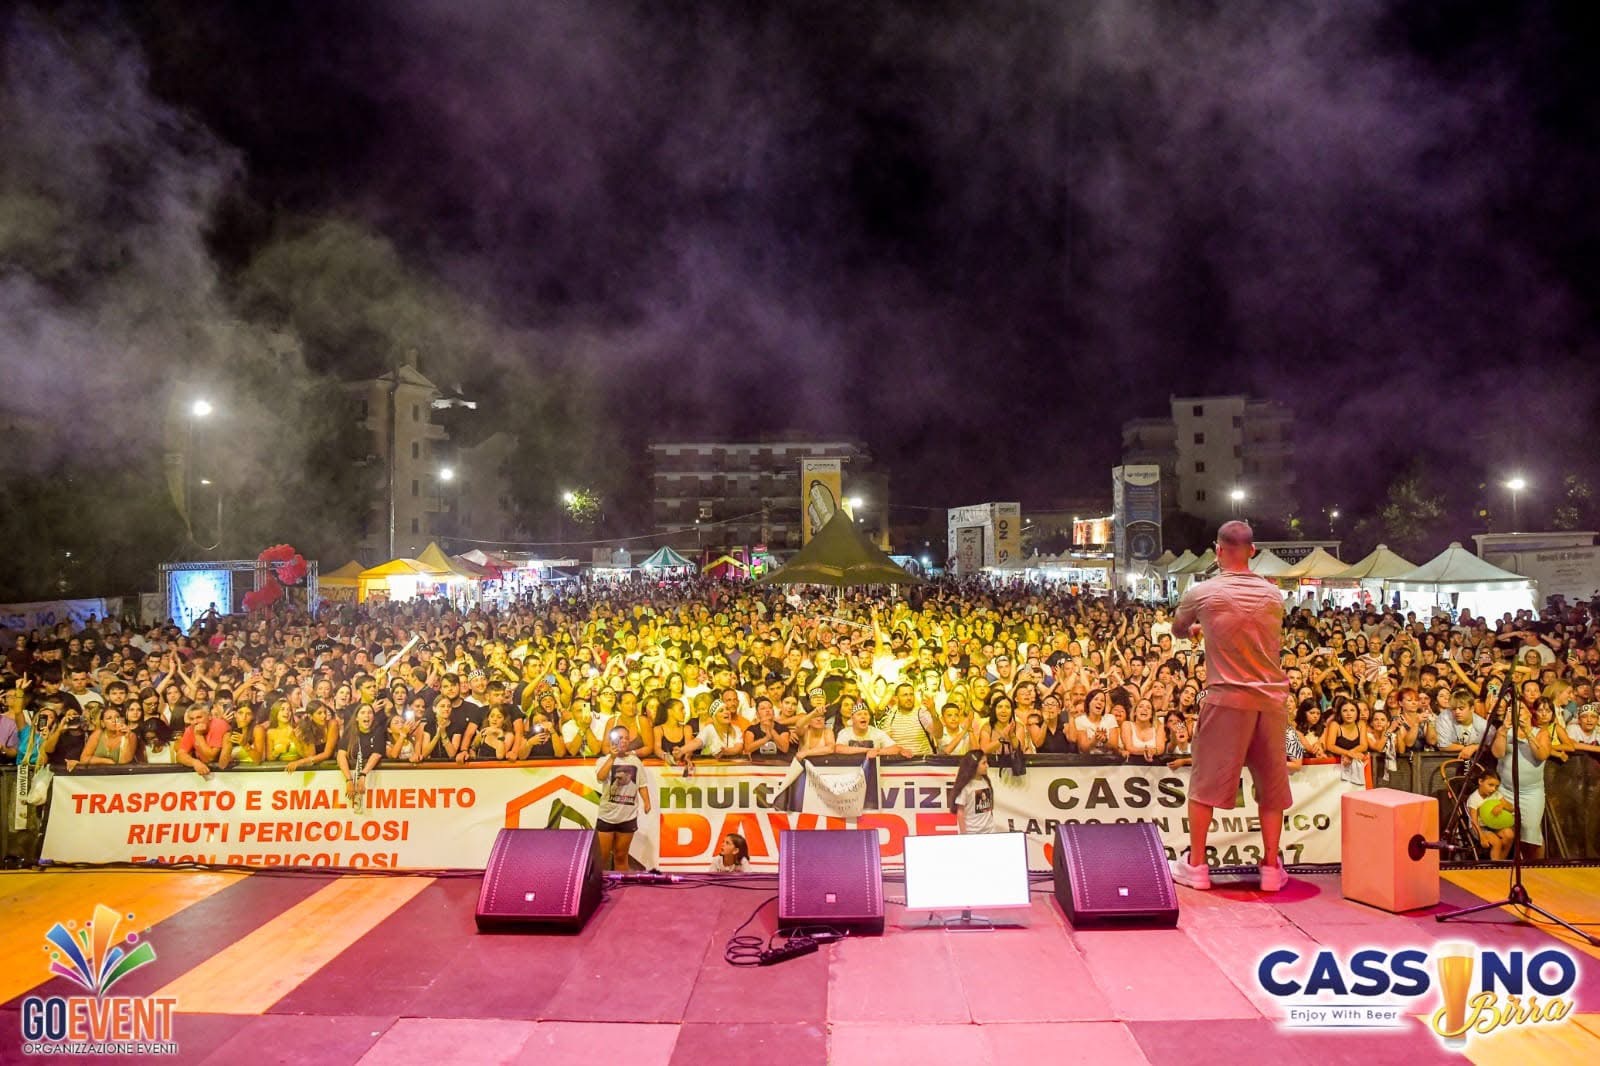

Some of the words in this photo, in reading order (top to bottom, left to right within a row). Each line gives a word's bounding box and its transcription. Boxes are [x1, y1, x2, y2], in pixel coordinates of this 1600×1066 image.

[71, 790, 236, 814] TRASPORTO
[245, 790, 262, 811] E
[271, 787, 477, 811] SMALIMENTO
[127, 822, 229, 844] RIFIUTI
[238, 820, 409, 842] PERICOLOSI
